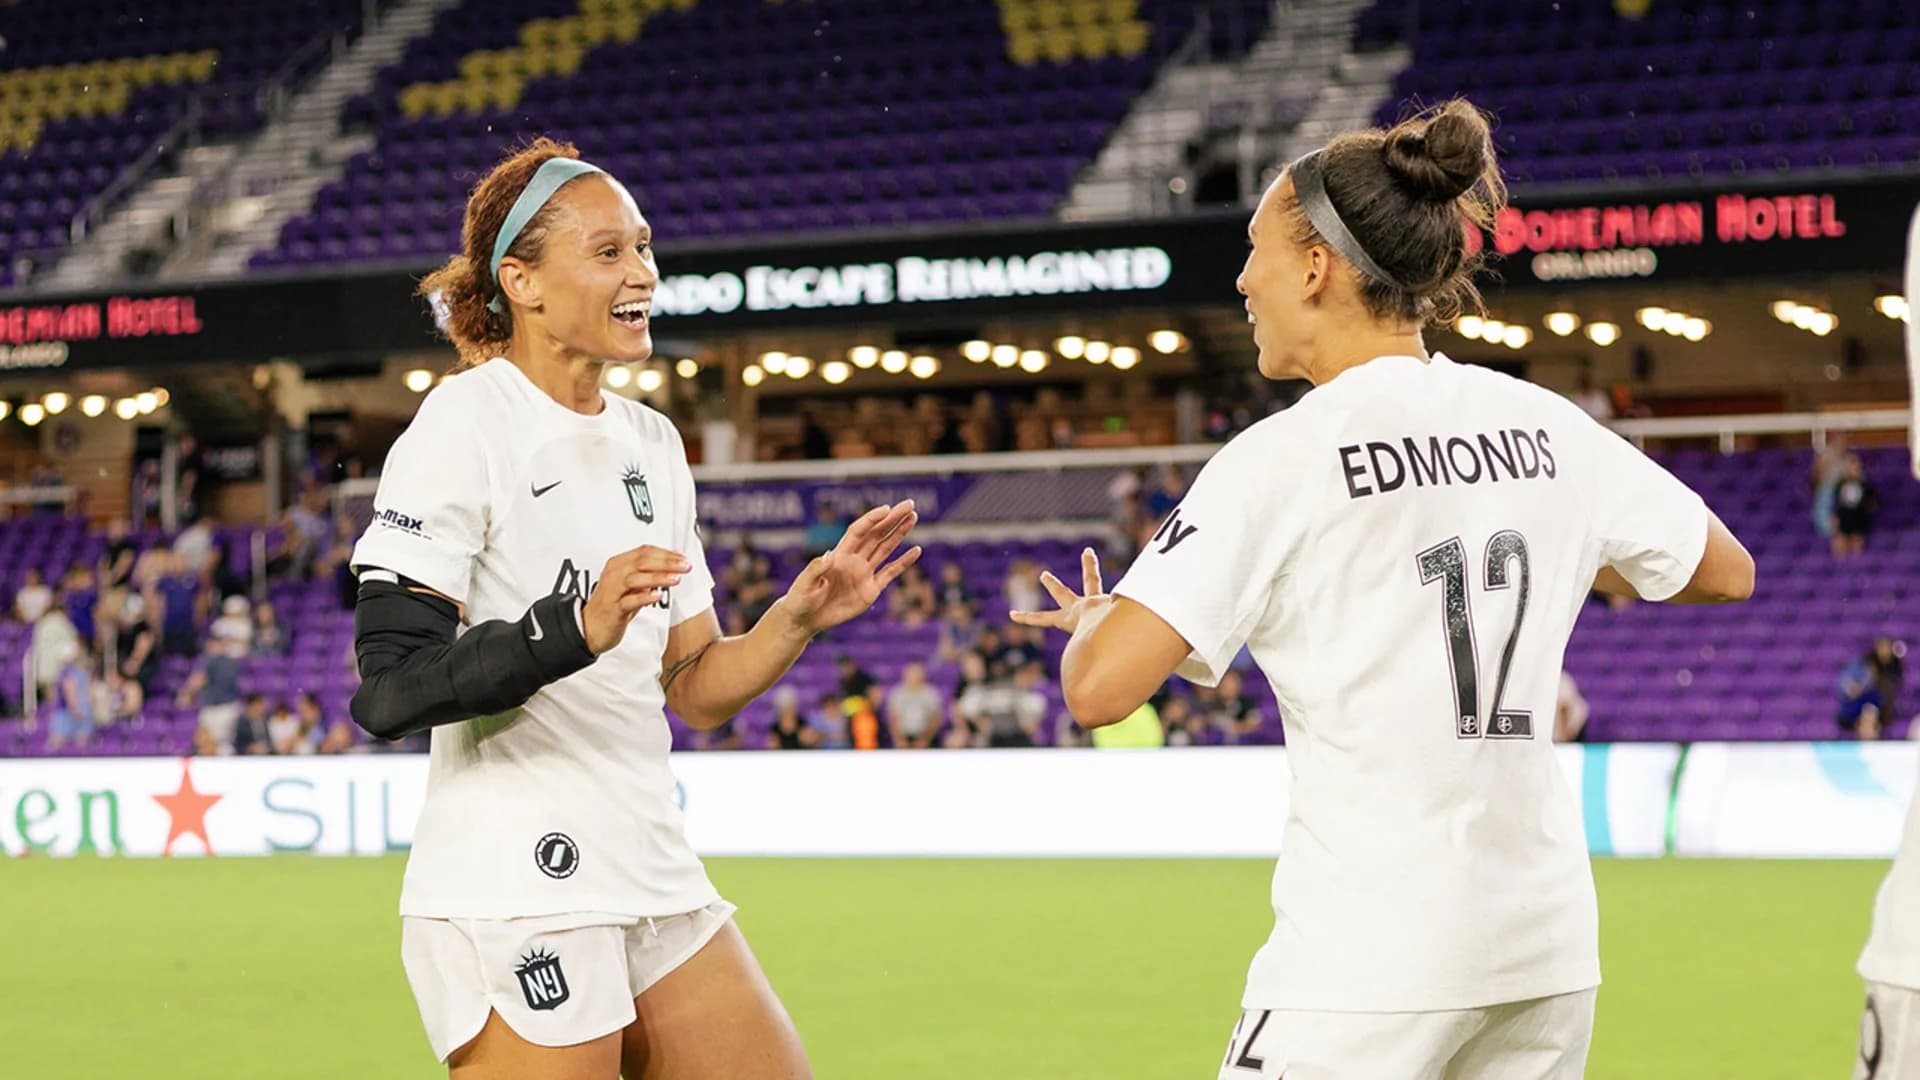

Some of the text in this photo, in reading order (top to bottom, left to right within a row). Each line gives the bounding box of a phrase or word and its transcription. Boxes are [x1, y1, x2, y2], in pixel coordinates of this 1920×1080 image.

[1494, 201, 1703, 255] BOHEMIAN
[1716, 193, 1846, 243] HOTEL
[745, 263, 893, 311] ESCAPE
[896, 247, 1171, 302] REIMAGINED
[107, 296, 203, 338] HOTEL
[1338, 428, 1557, 499] EDMONDS
[1415, 529, 1534, 740] 12
[0, 789, 126, 855] en
[524, 964, 563, 1005] NY
